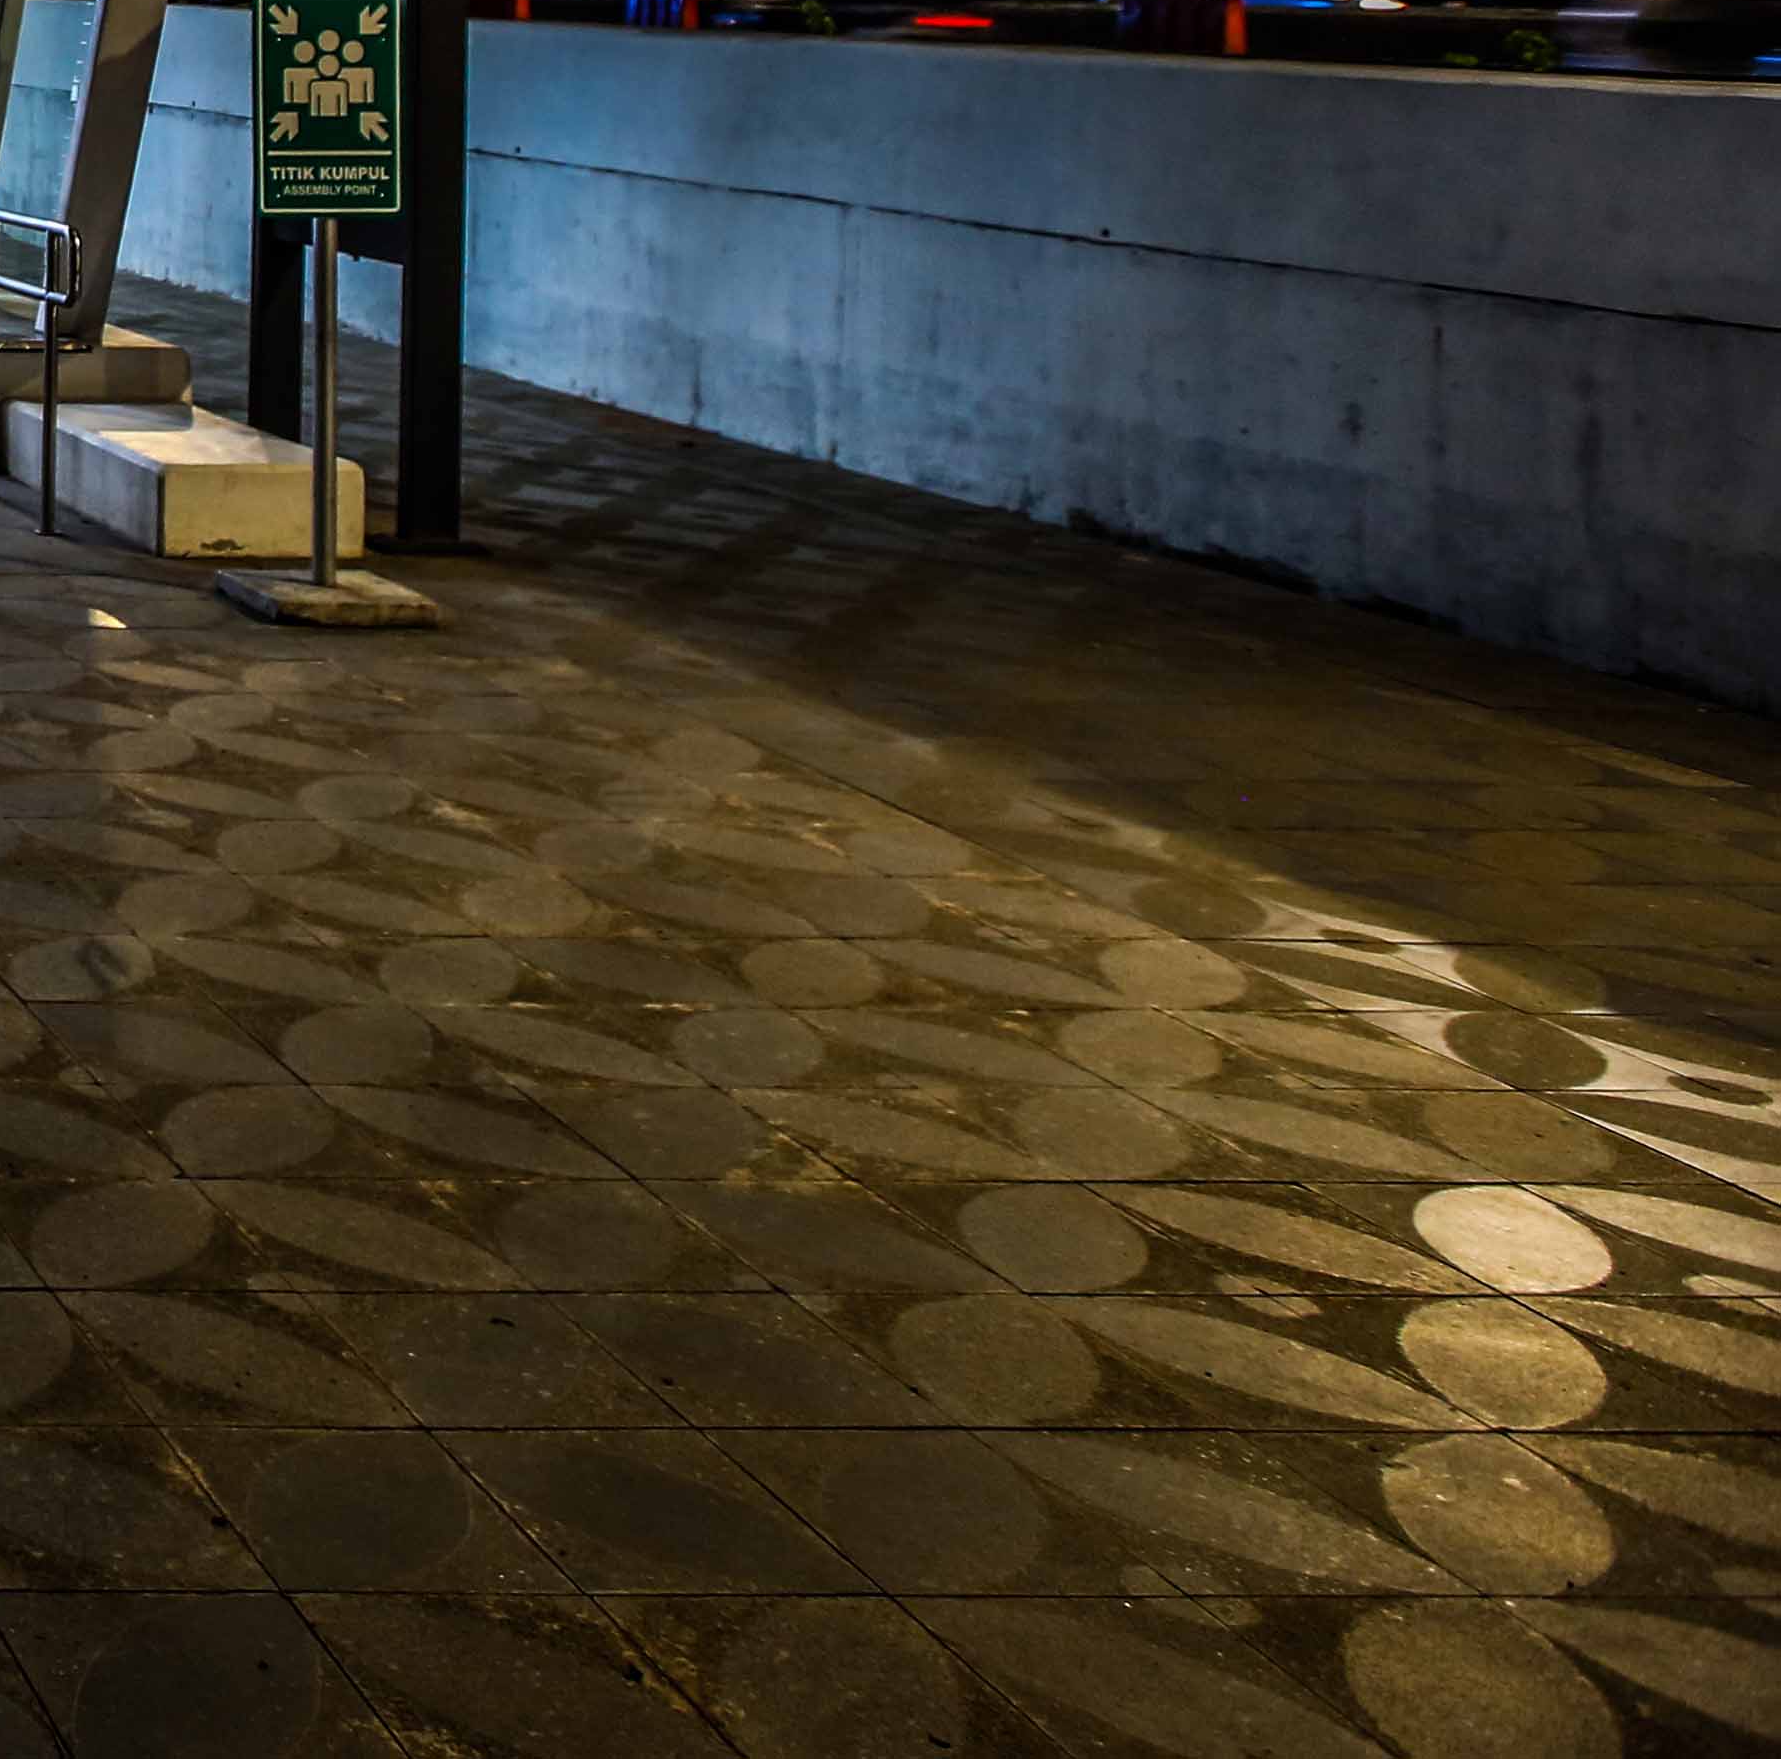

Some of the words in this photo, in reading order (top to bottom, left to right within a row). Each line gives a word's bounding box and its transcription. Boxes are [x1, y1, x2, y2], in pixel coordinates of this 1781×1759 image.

[270, 166, 315, 180] TITIK
[320, 167, 390, 180] KUMPUL
[283, 184, 341, 195] ASSEMBLY
[344, 184, 376, 195] POINT
